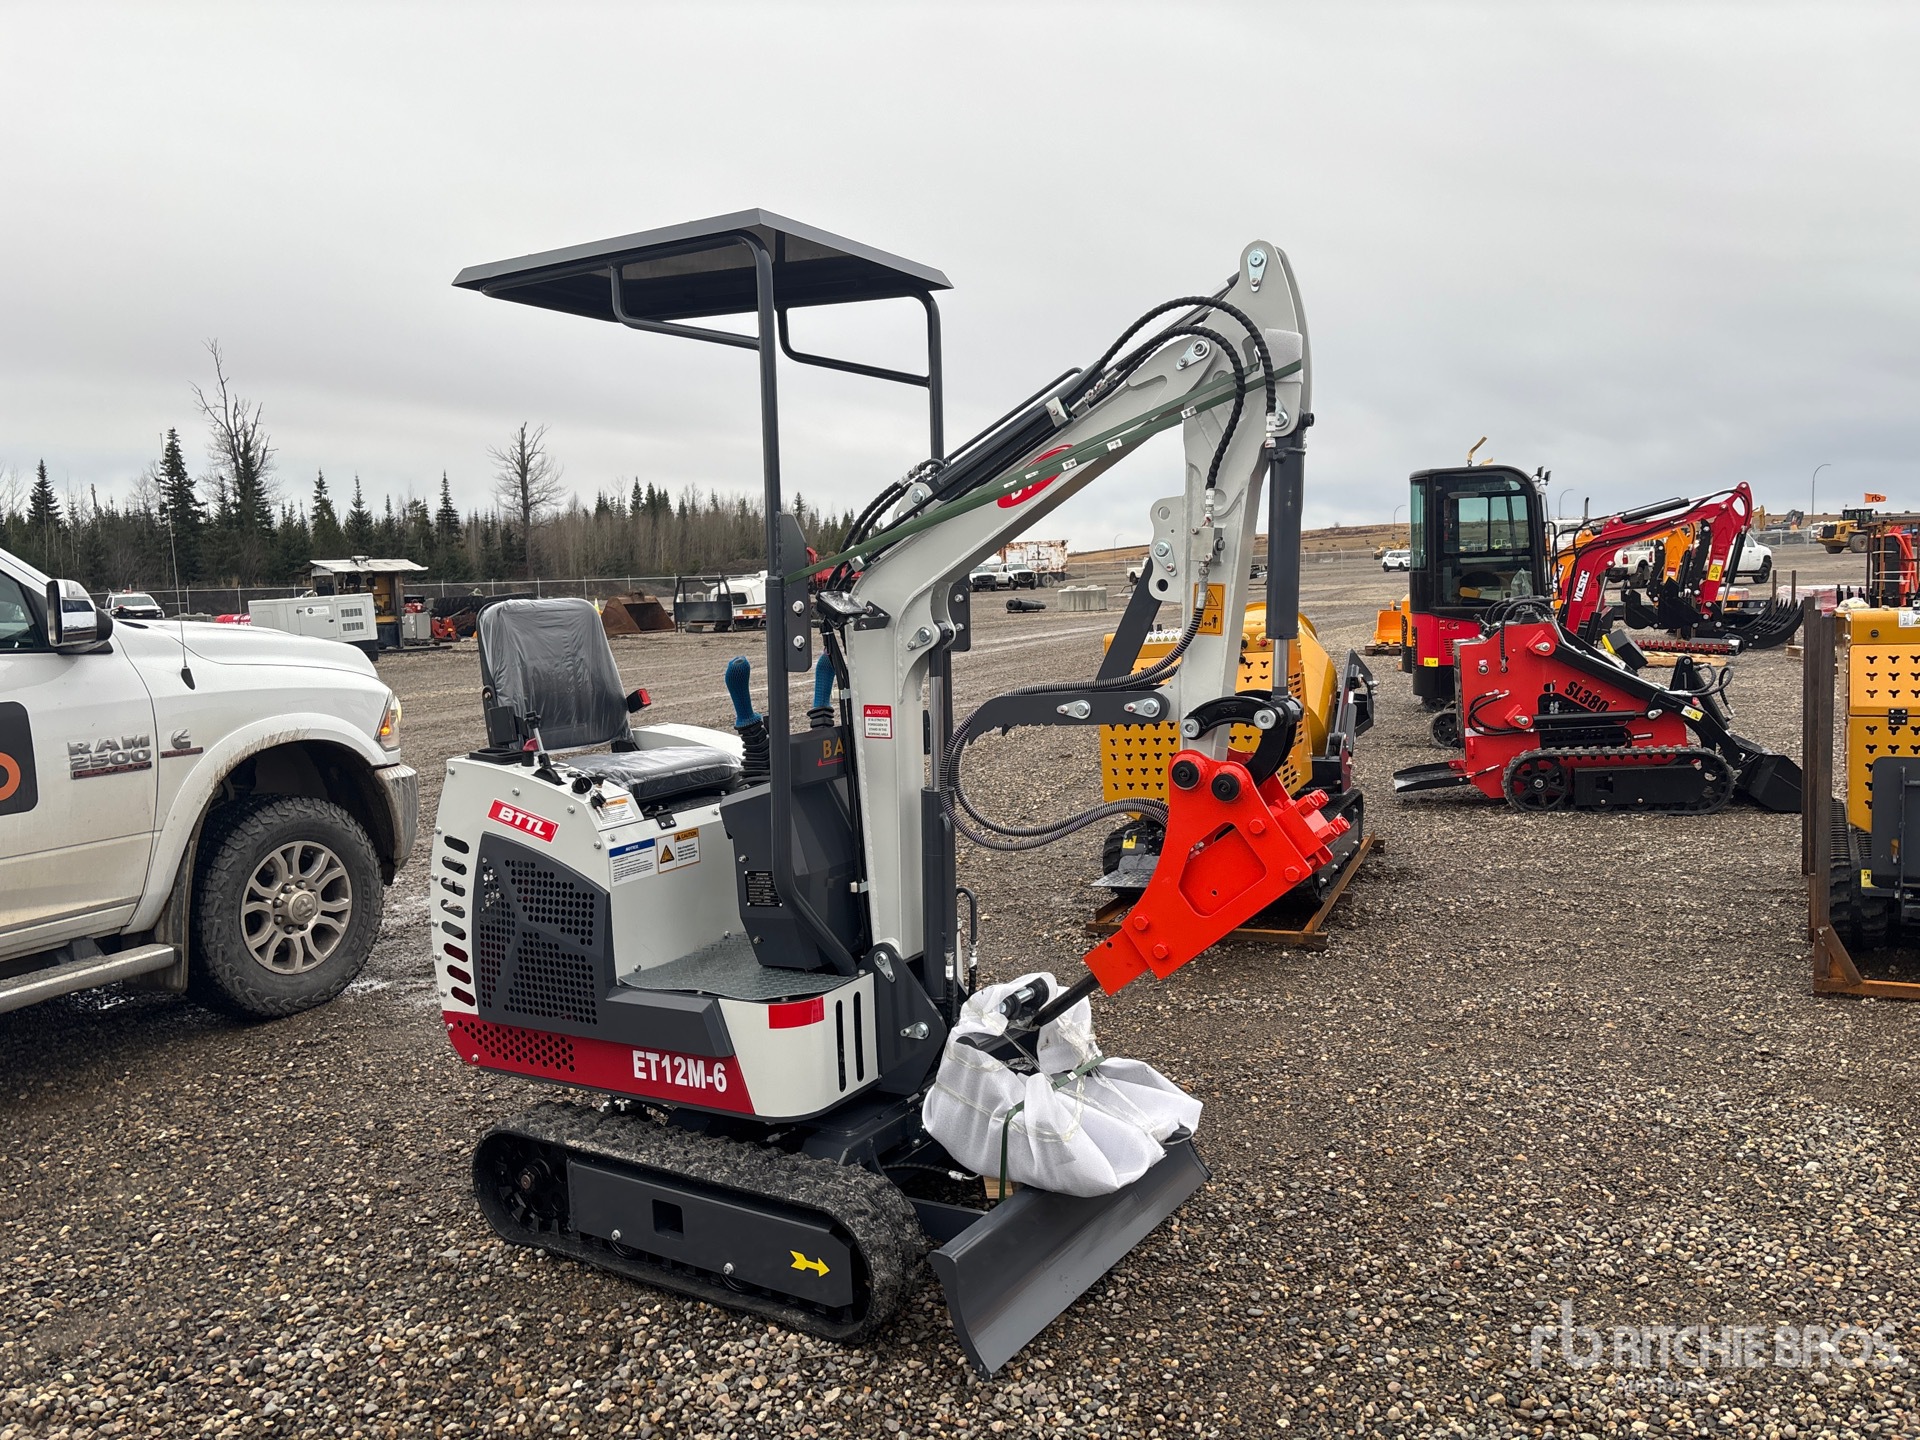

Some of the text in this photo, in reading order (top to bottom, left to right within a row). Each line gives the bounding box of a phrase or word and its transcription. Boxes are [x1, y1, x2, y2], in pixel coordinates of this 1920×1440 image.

[1572, 569, 1591, 602] VICSEC
[1565, 680, 1610, 712] SL380
[67, 733, 150, 756] RAM
[69, 748, 152, 770] 2500
[497, 806, 546, 836] BTTL
[680, 831, 697, 839] CAUTION
[352, 875, 371, 951] COOPER
[632, 1049, 727, 1093] ET12M-6
